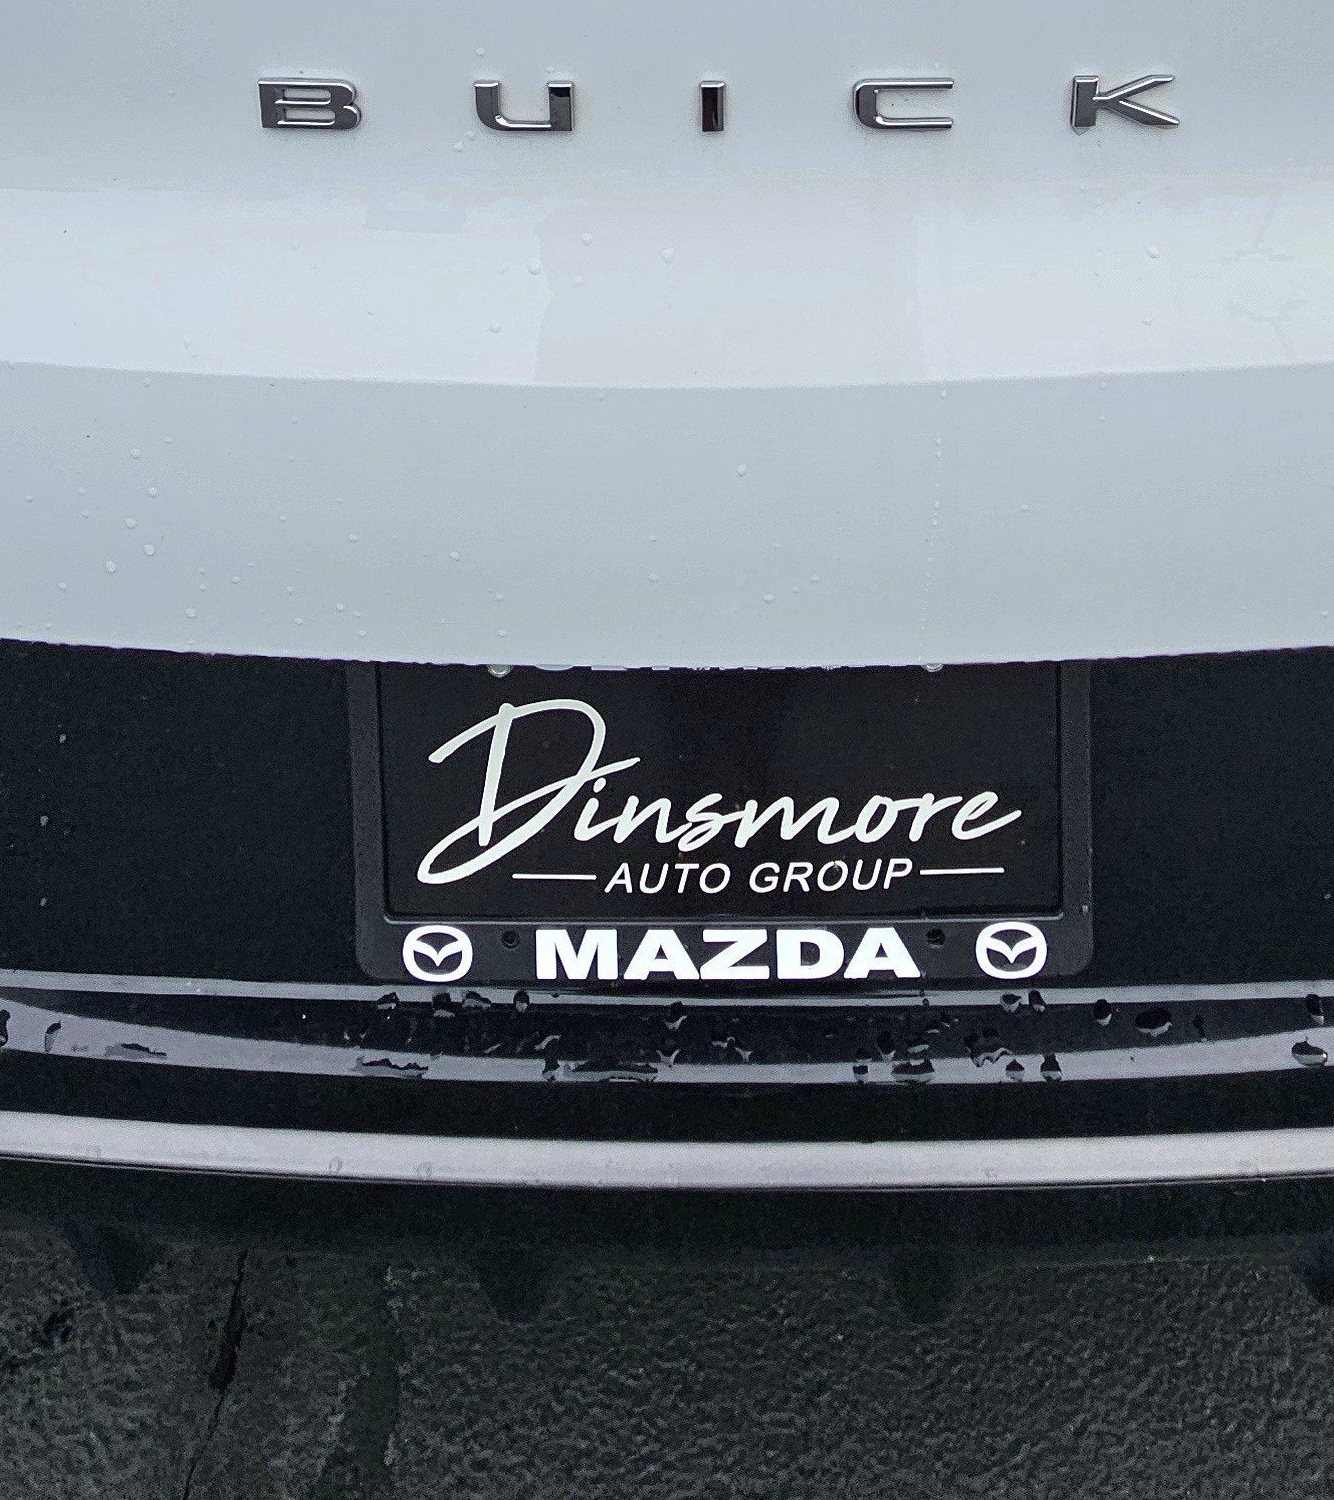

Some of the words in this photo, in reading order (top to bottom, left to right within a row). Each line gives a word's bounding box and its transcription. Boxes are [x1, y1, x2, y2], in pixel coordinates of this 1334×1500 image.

[257, 75, 1181, 134] BUICK
[417, 698, 1023, 885] Dinsmore
[603, 862, 732, 895] AUTO
[748, 858, 913, 893] GROUP
[535, 927, 922, 980] MAZDA
